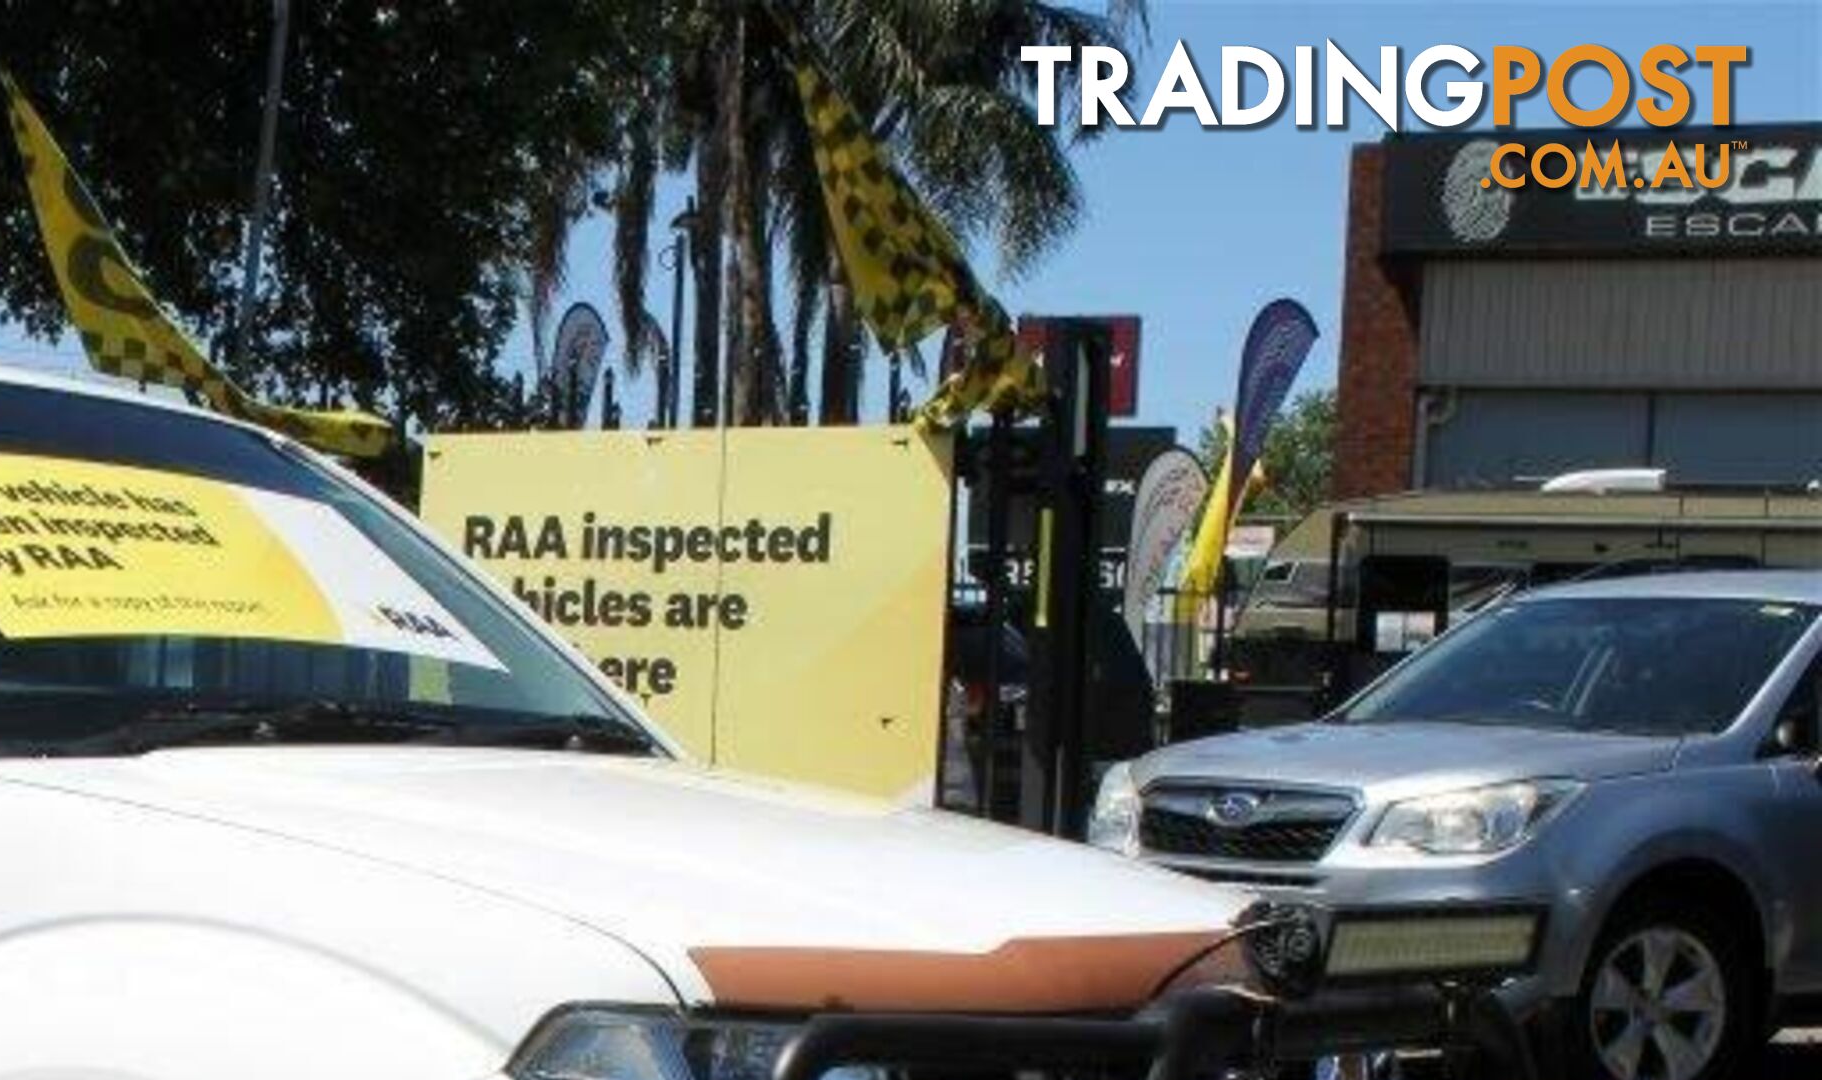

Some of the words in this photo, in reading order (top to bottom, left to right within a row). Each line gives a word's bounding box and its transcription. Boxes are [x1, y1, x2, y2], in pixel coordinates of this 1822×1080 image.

[1645, 212, 1822, 237] ESCA
[125, 488, 198, 517] has
[30, 510, 220, 546] inspected
[465, 515, 568, 560] RAA
[583, 511, 832, 572] inspected
[24, 545, 123, 570] RAA
[378, 606, 460, 640] RAA
[665, 592, 748, 629] are
